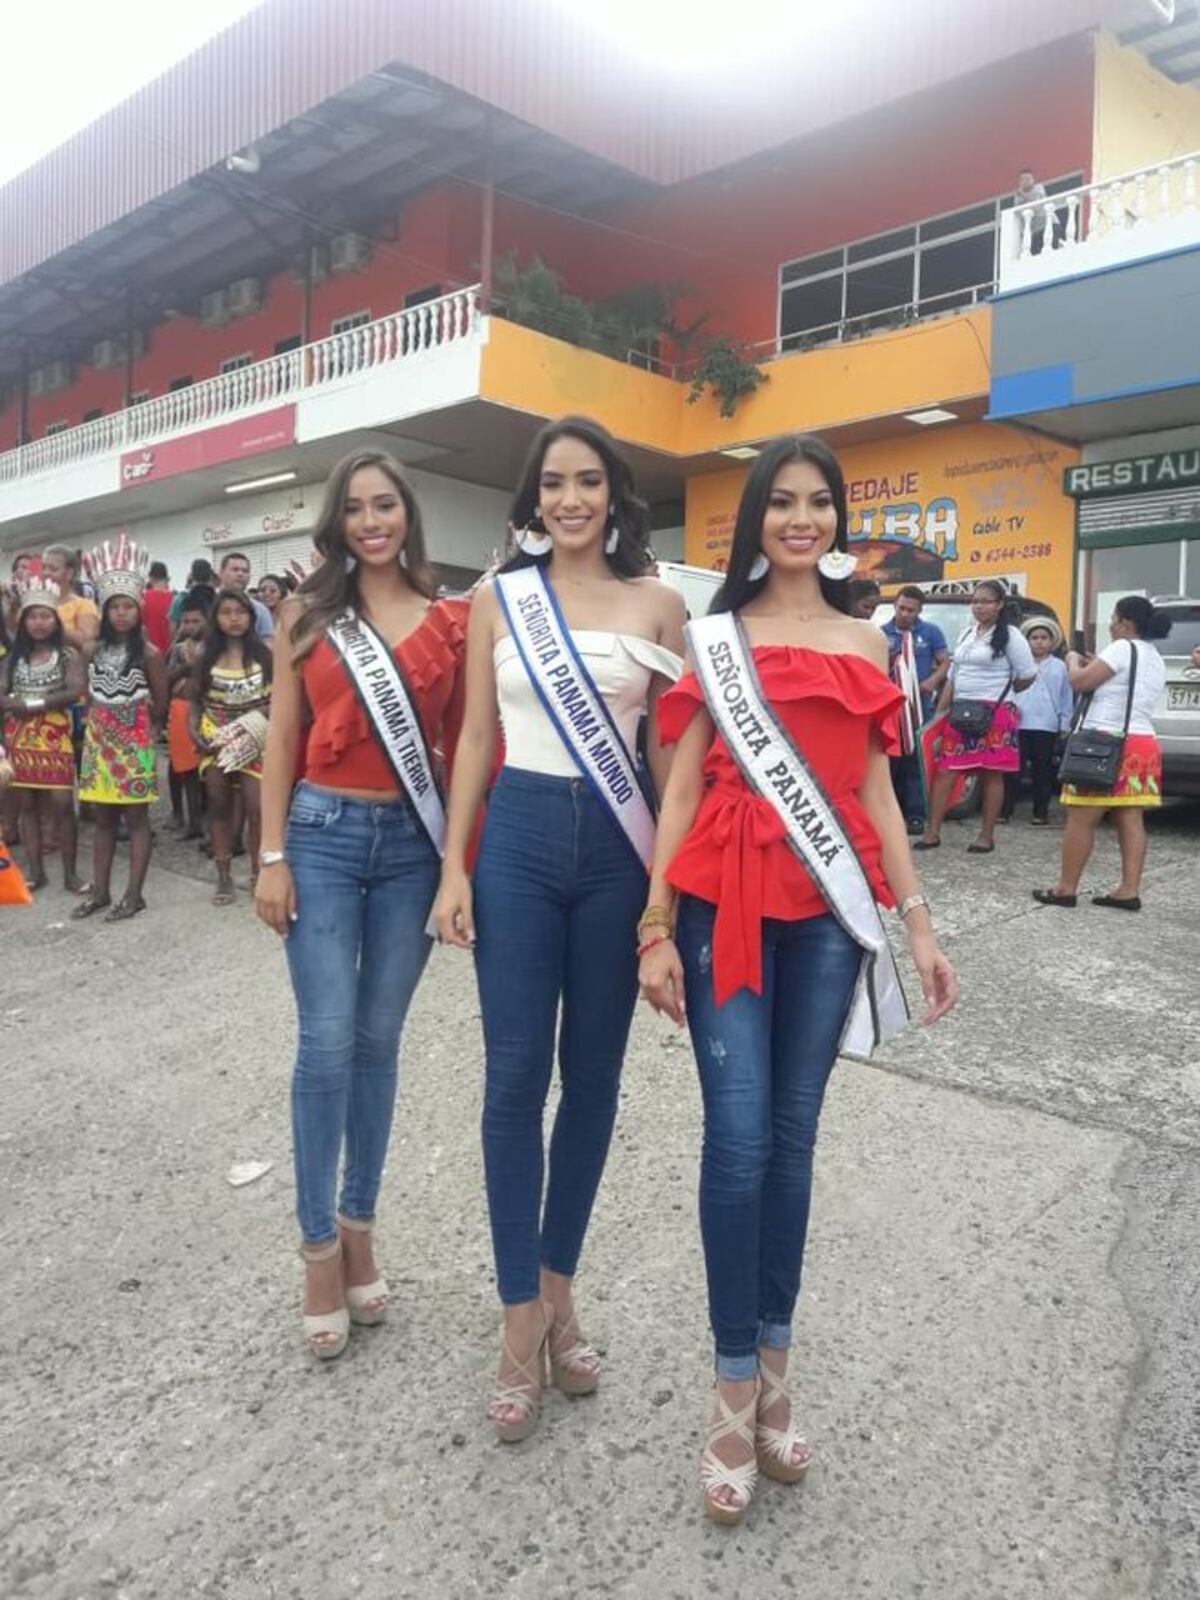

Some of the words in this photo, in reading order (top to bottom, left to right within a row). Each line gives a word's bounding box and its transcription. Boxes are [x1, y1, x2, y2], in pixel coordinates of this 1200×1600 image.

[1070, 451, 1200, 491] RESTAU
[1006, 516, 1024, 531] TV
[517, 593, 560, 665] SEÑORITA
[547, 664, 604, 743] PANAMÁ
[588, 739, 634, 805] MUNDO
[398, 742, 429, 797] TIERRA
[708, 641, 771, 756] SEÑORITA
[765, 761, 844, 867] PANAMÁ
